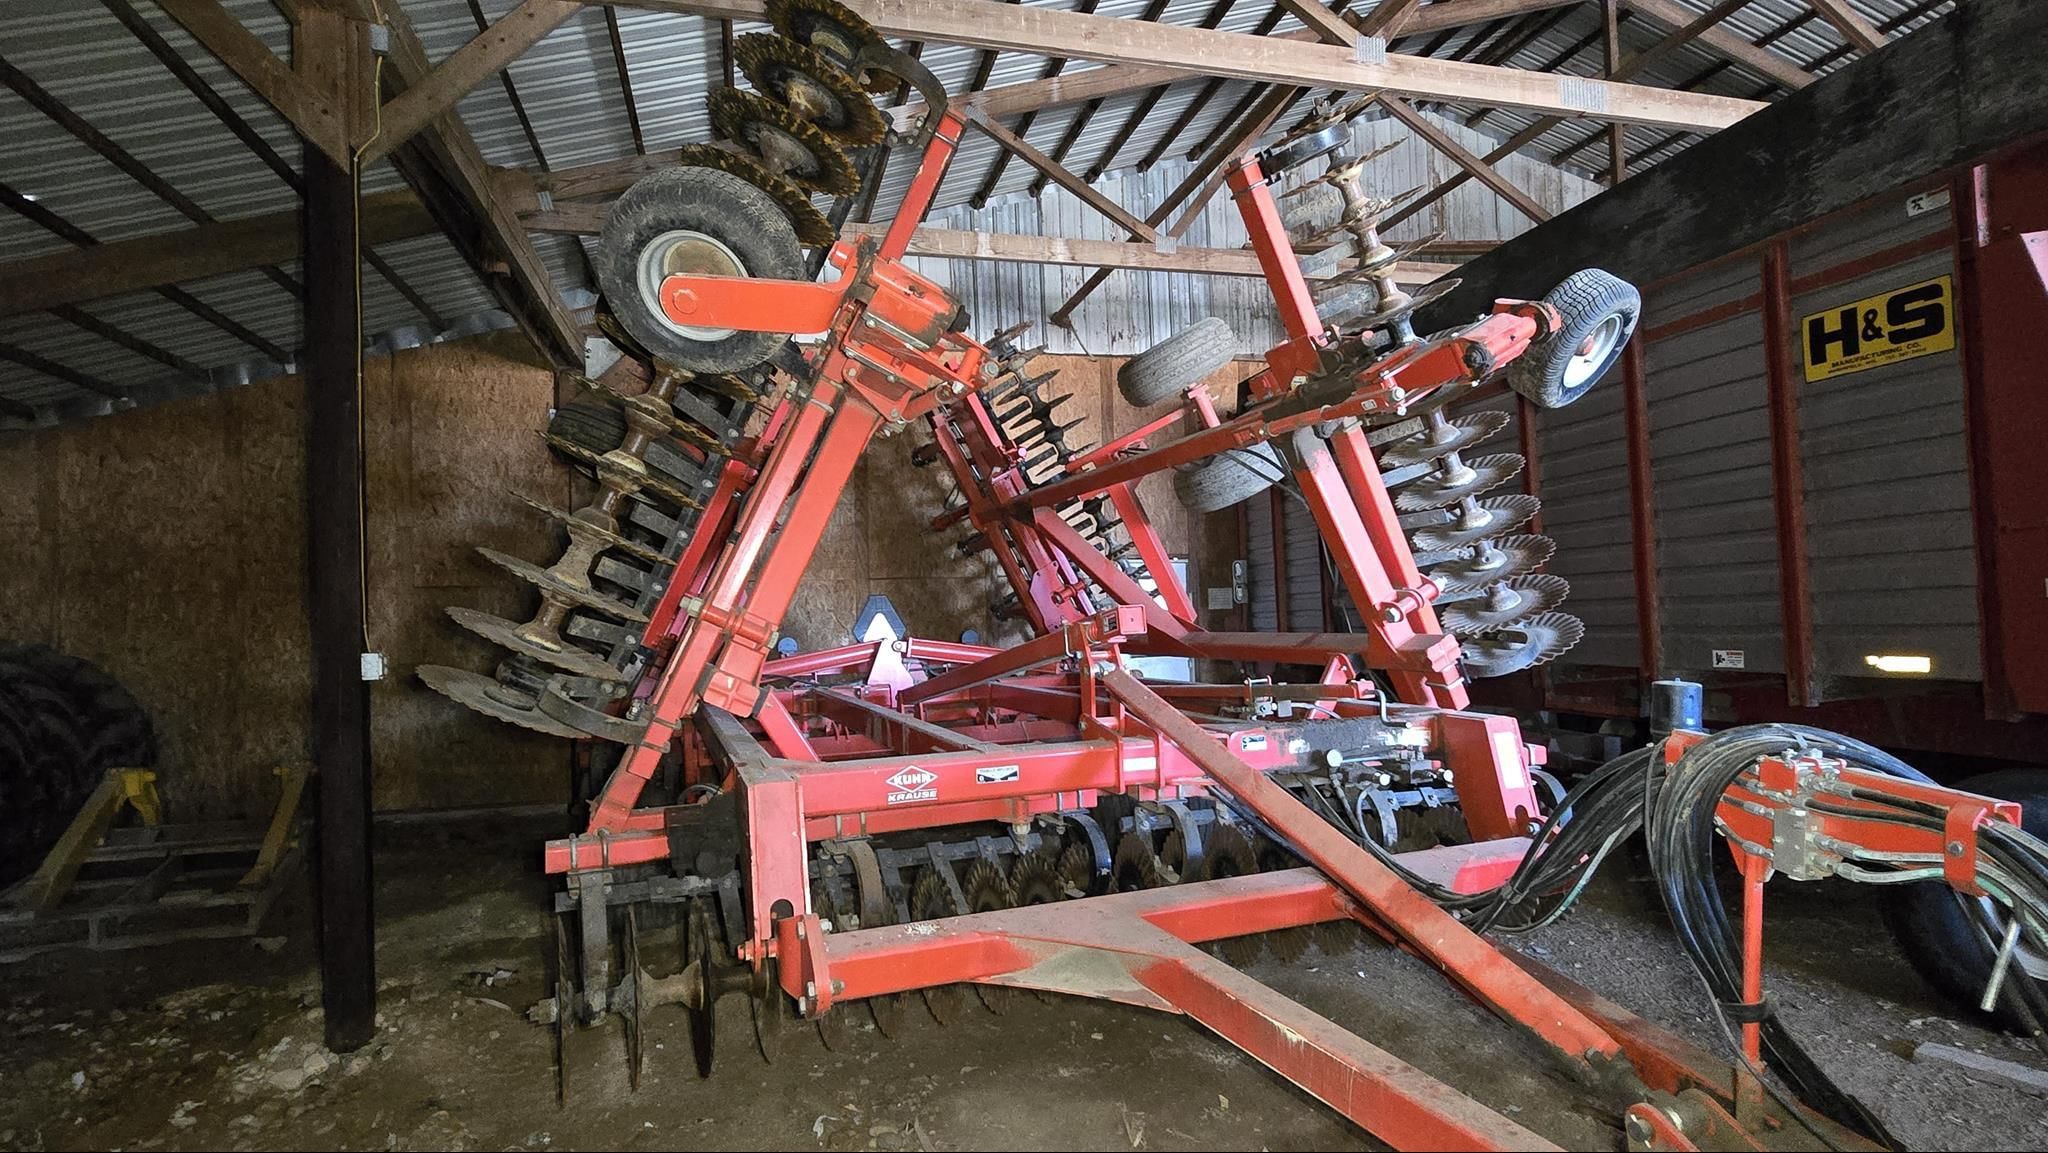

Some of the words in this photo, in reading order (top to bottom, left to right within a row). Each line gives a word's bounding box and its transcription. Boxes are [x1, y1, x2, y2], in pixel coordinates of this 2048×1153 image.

[1808, 283, 1946, 366] H&S
[1831, 345, 1903, 368] MANUFACTURING
[893, 772, 932, 786] KUHN
[888, 790, 937, 802] KRAUSE
